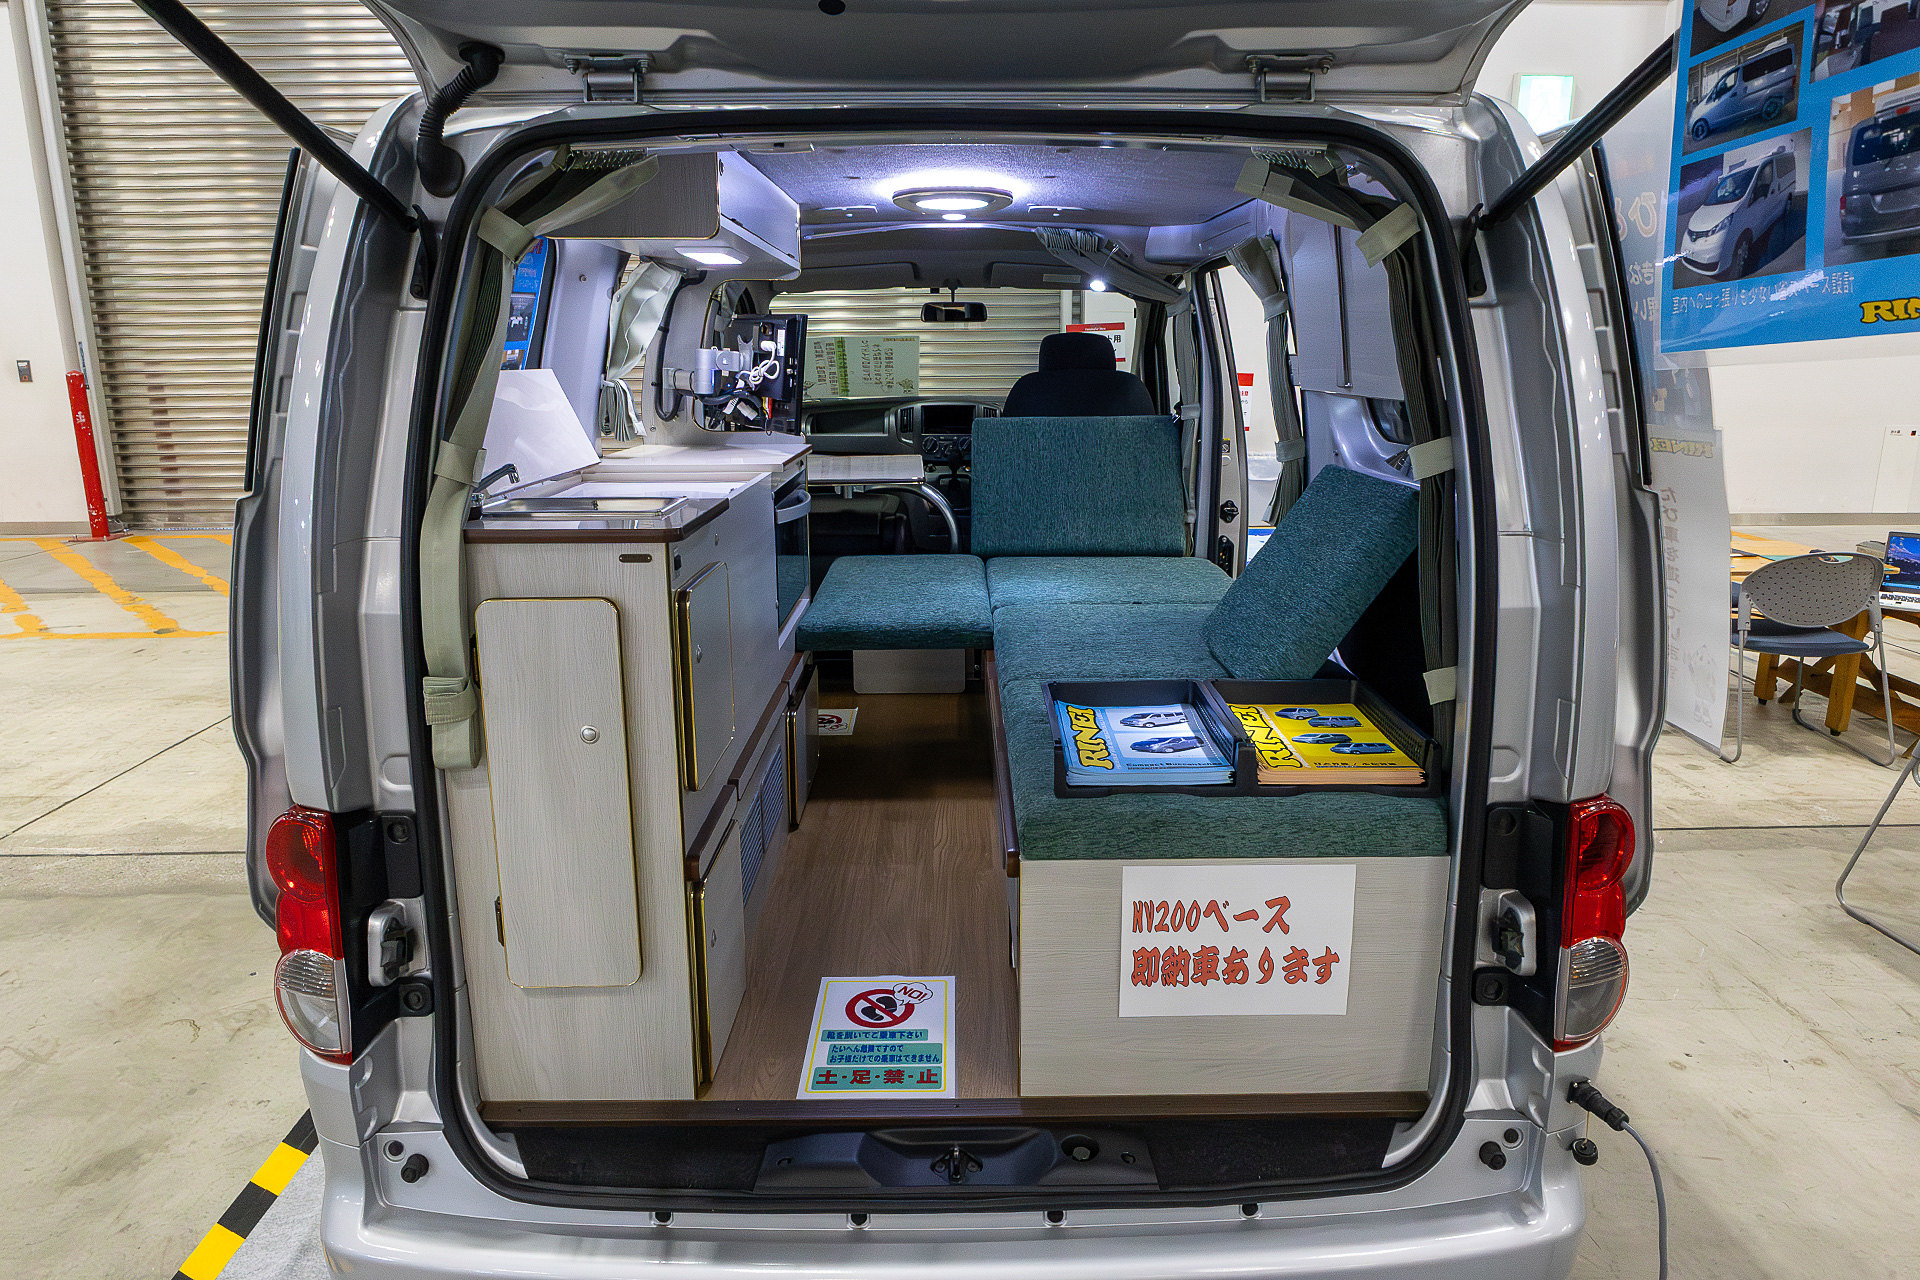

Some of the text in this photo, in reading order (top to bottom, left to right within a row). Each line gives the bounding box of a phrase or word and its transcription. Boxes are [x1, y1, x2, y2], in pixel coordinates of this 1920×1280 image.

[1066, 705, 1114, 770] RINEI
[1229, 705, 1303, 768] RINEI
[1132, 895, 1291, 934] NV200ベース
[1131, 945, 1340, 987] 即納車あります
[897, 985, 928, 1001] NO!
[827, 1031, 922, 1039] 靴を脱いでご乗車下さい
[832, 1045, 904, 1053] たいへん危険ですので
[829, 1054, 940, 1063] お子様だけでの乗車はできません
[815, 1069, 939, 1084] 土・足・禁・止
